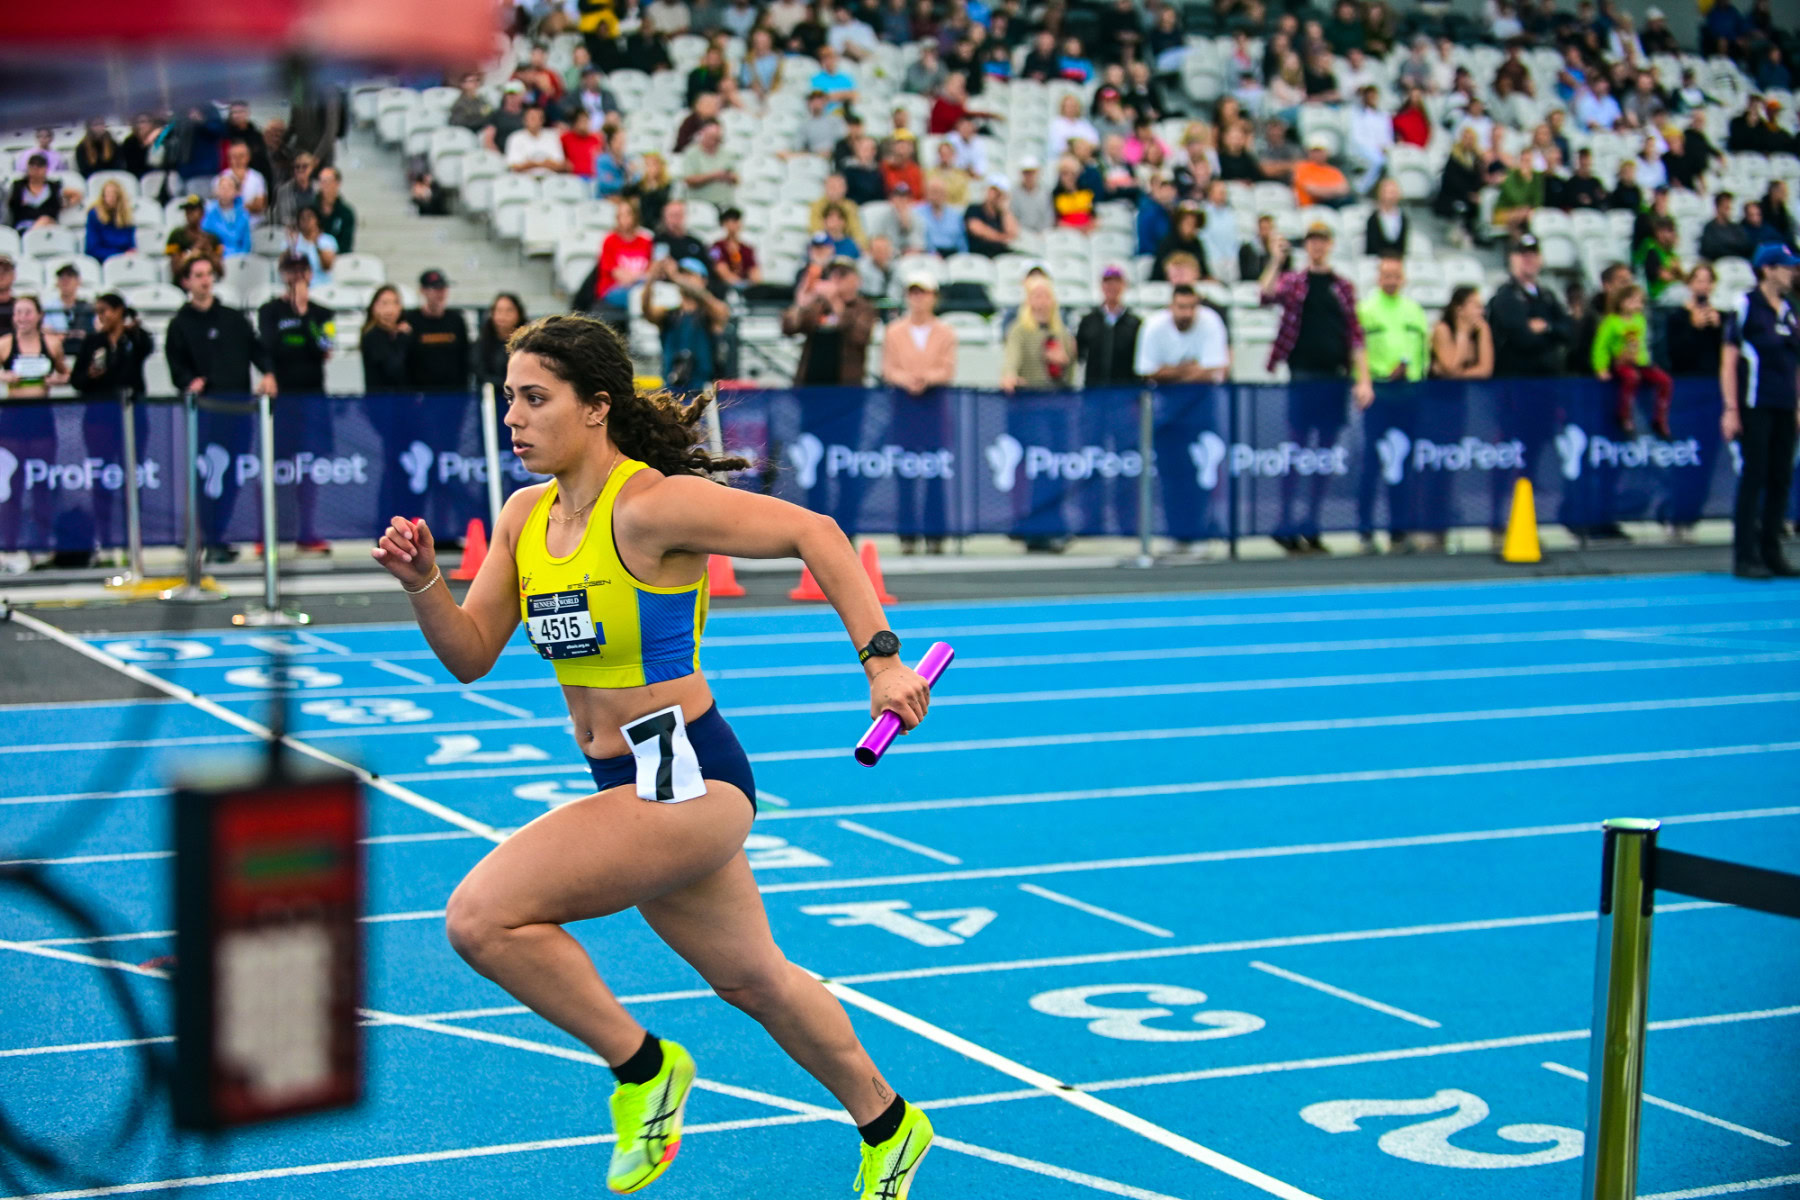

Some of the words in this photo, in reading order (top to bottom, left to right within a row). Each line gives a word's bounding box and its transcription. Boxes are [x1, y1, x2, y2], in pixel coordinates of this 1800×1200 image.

[826, 445, 955, 479] ProFeet
[1231, 442, 1349, 477] ProFeet
[1414, 437, 1526, 471] ProFeet
[1590, 435, 1700, 468] ProFeet
[236, 453, 368, 486] PoFeet
[559, 597, 580, 606] WORLD
[541, 616, 581, 641] 4515
[301, 698, 433, 724] 8
[426, 735, 550, 765] 7
[627, 711, 677, 801] 7
[801, 899, 998, 948] 4
[1029, 983, 1266, 1042] 3
[1299, 1088, 1585, 1169] 2
